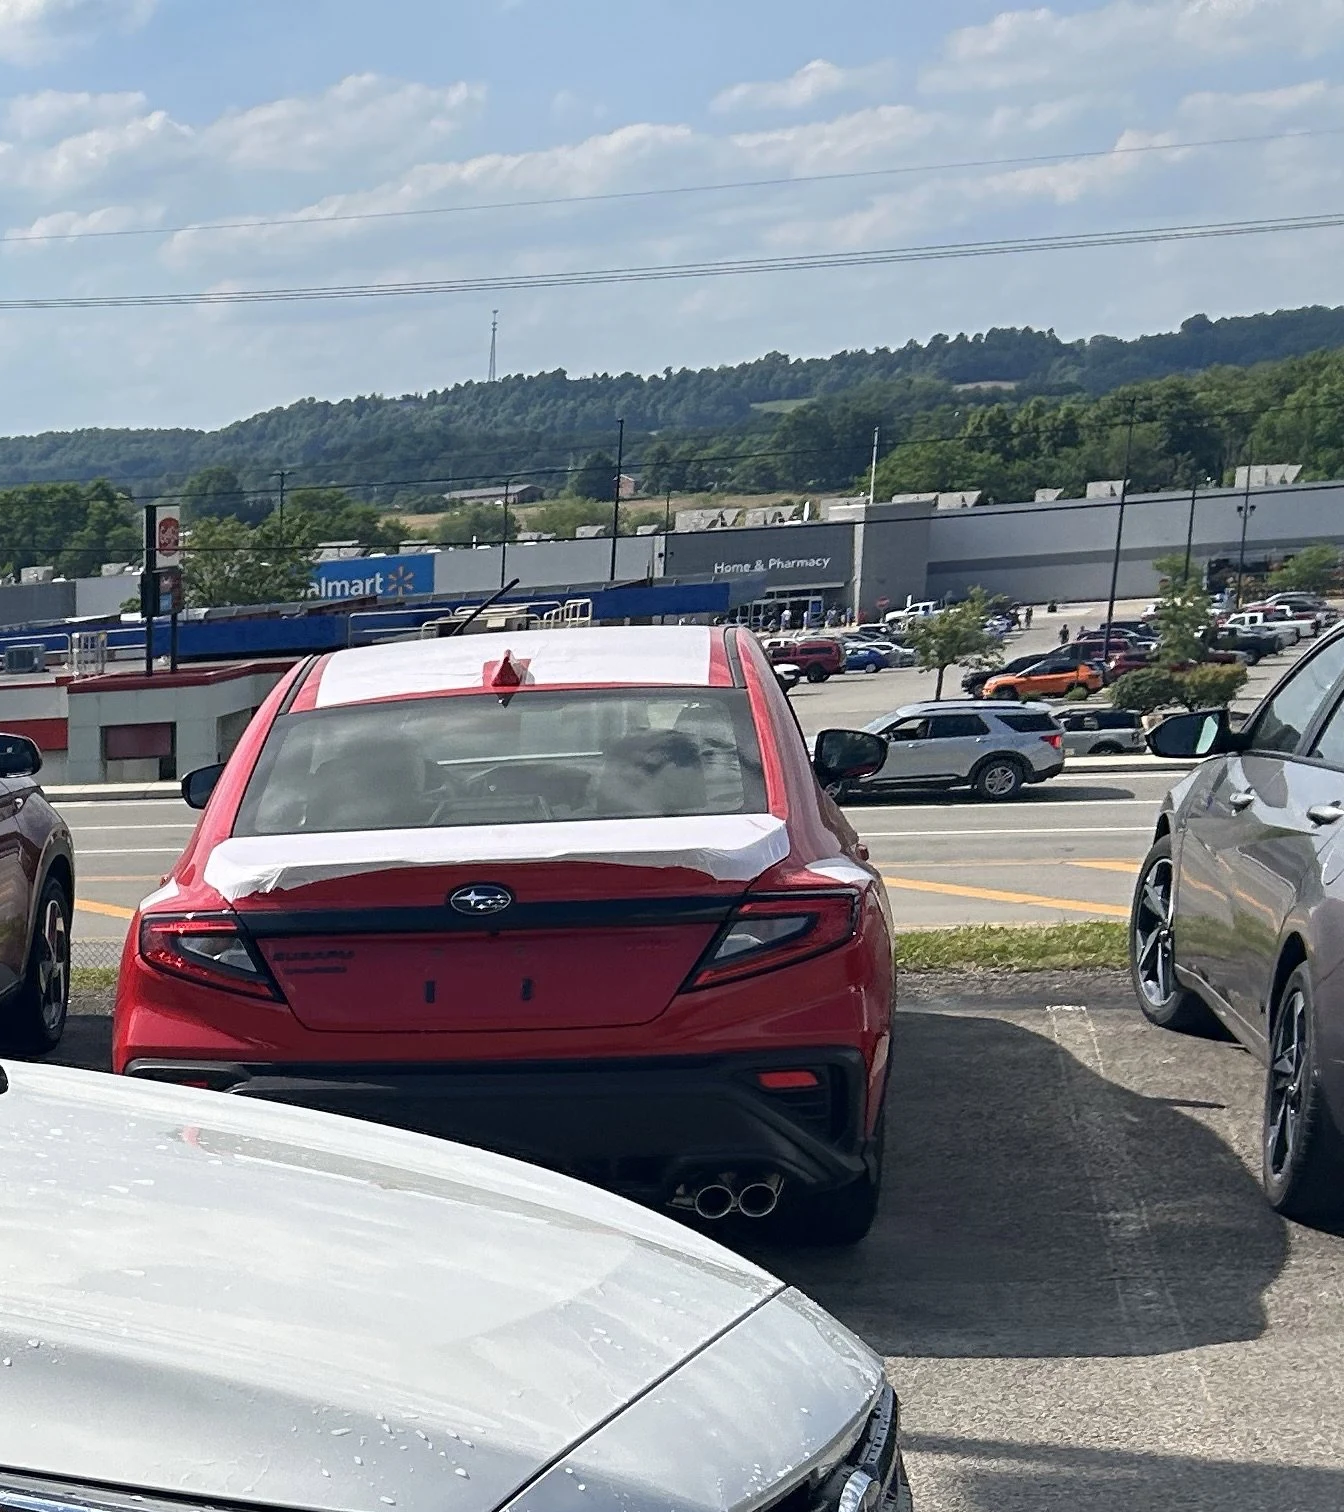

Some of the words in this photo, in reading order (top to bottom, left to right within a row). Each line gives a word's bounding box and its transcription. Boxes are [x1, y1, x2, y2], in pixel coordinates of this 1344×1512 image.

[714, 562, 751, 574] Home
[754, 560, 765, 571] &
[768, 557, 831, 570] Pharmacy
[299, 572, 384, 598] almart
